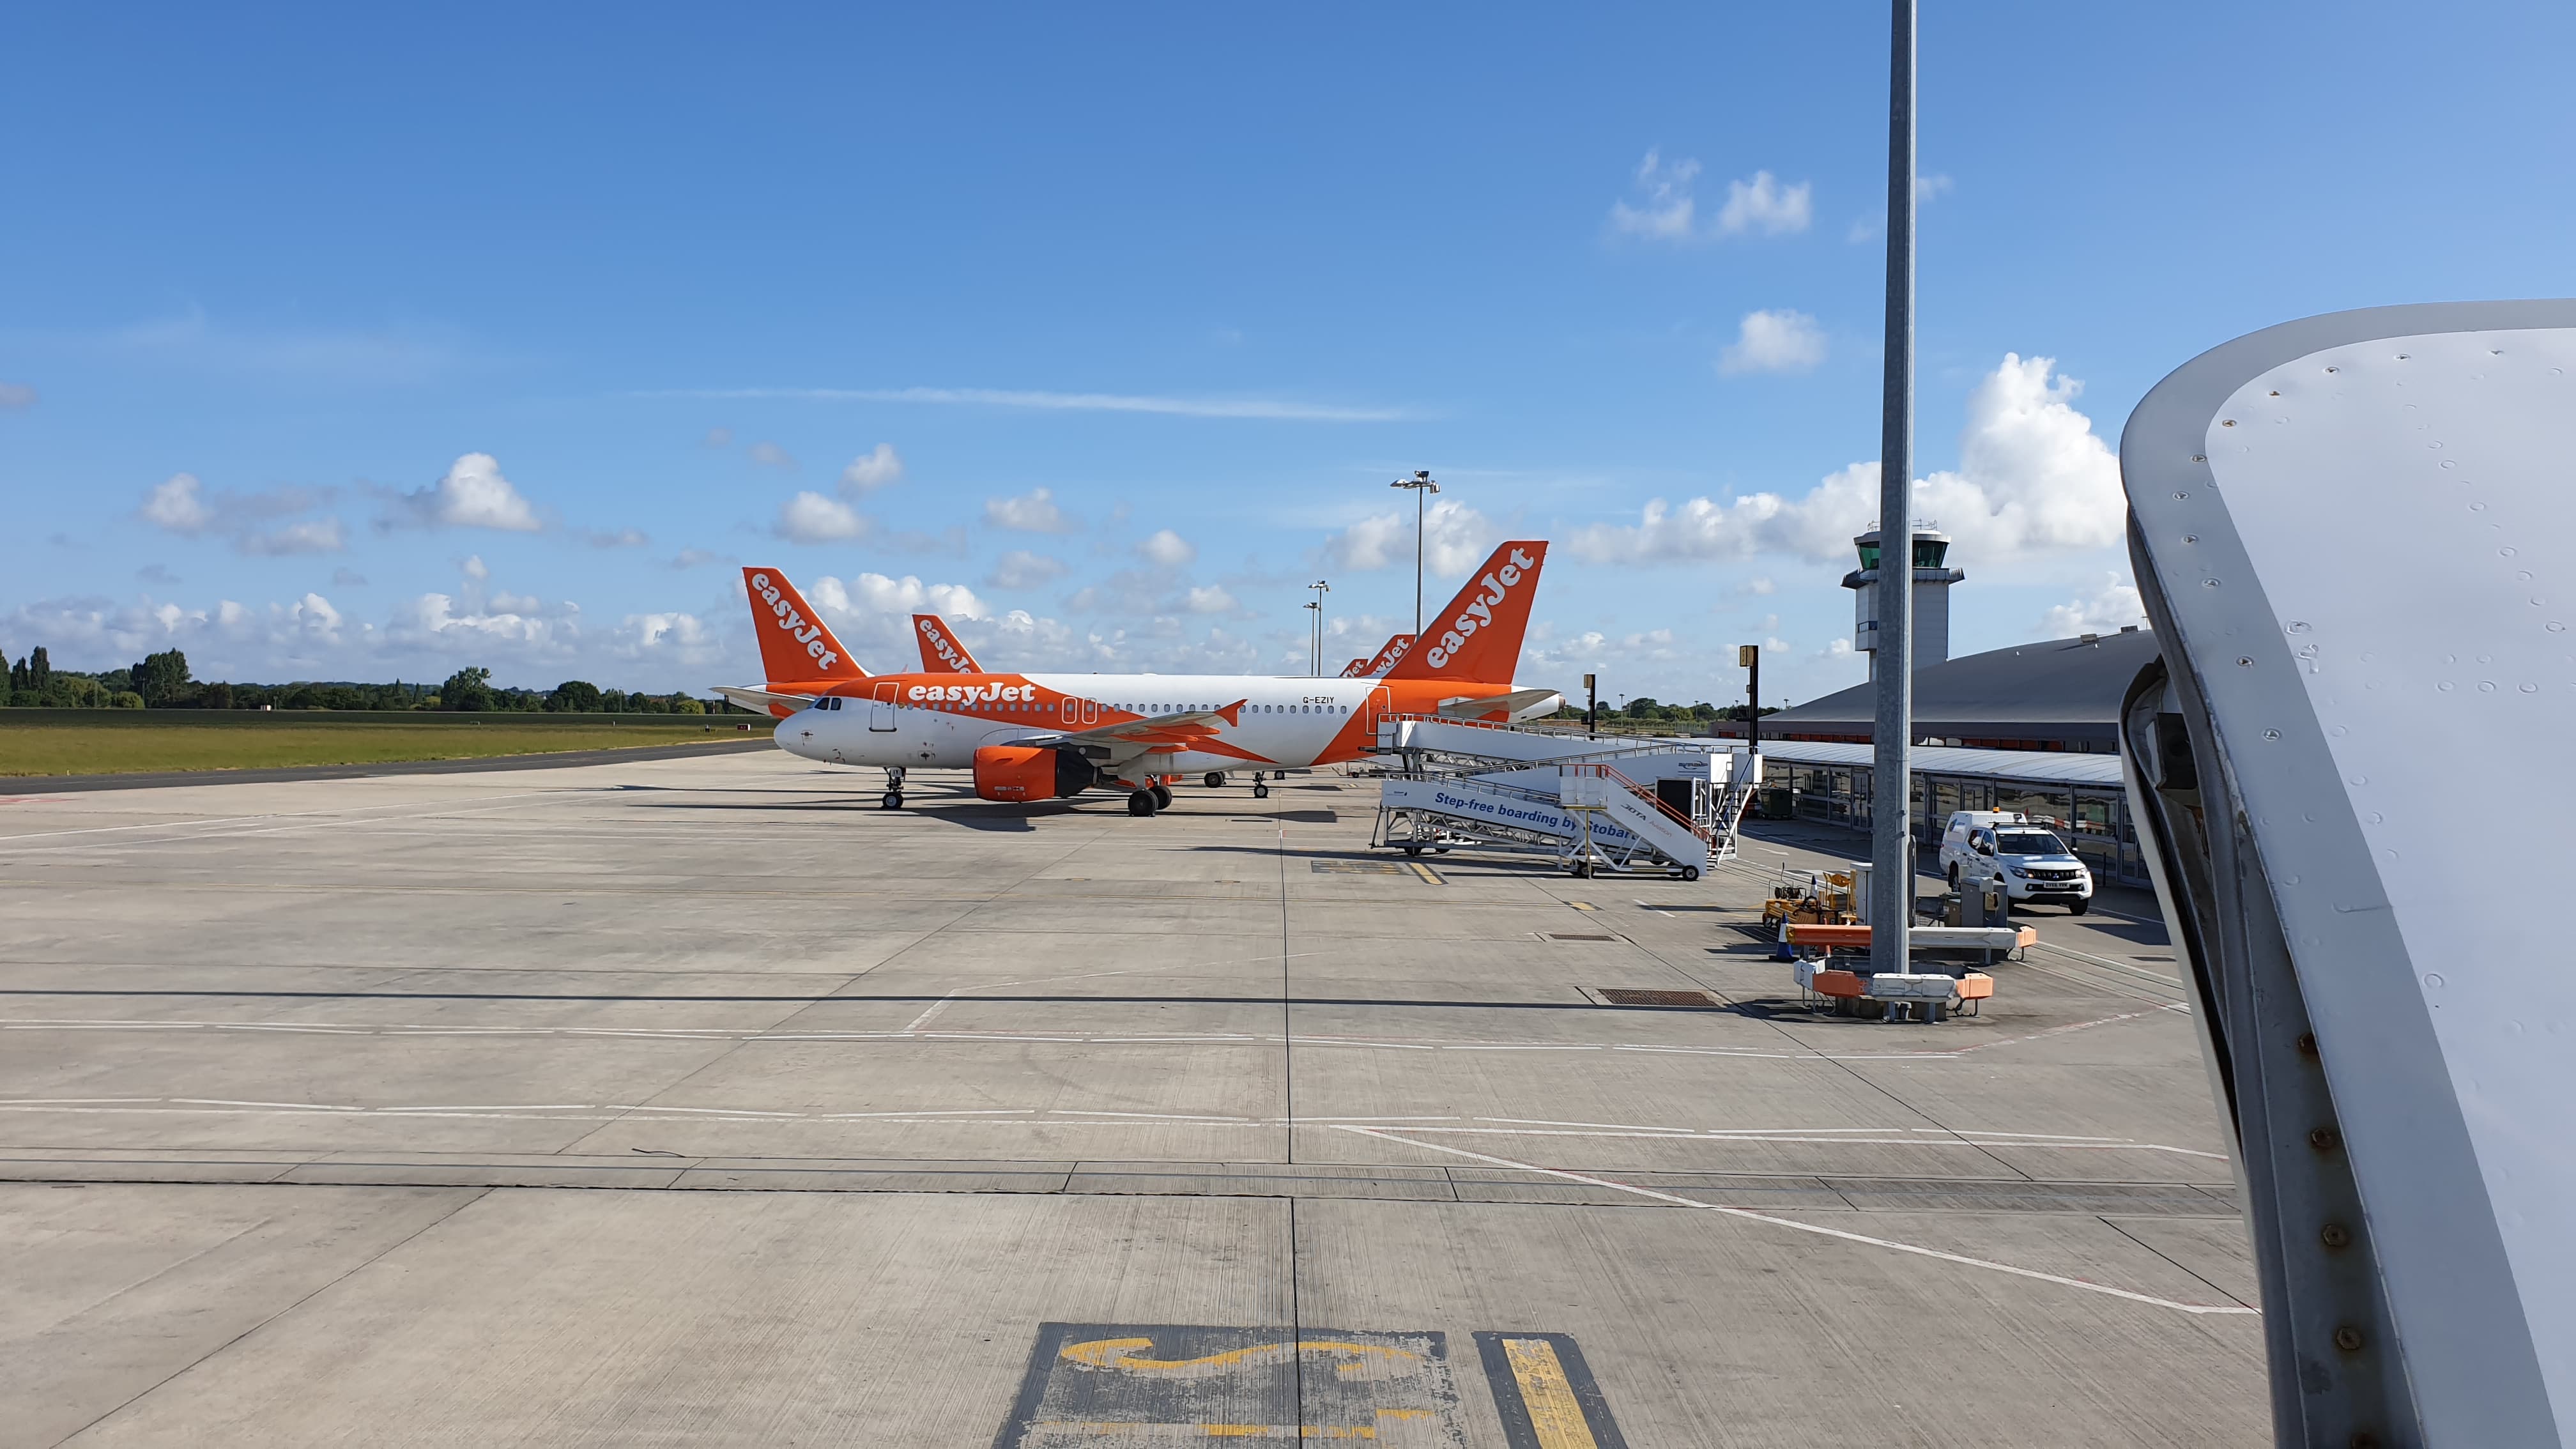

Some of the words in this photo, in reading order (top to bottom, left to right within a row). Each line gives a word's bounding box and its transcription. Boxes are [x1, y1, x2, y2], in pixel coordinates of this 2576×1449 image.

[751, 573, 838, 670] easyJet
[1427, 547, 1535, 668] easyJet
[908, 682, 1035, 706] easyJet
[1435, 792, 1494, 813] Step-free
[1498, 804, 1558, 827] boarding
[1561, 816, 1577, 831] by
[1620, 803, 1646, 821] JOTA
[1648, 820, 1672, 838] Aviation
